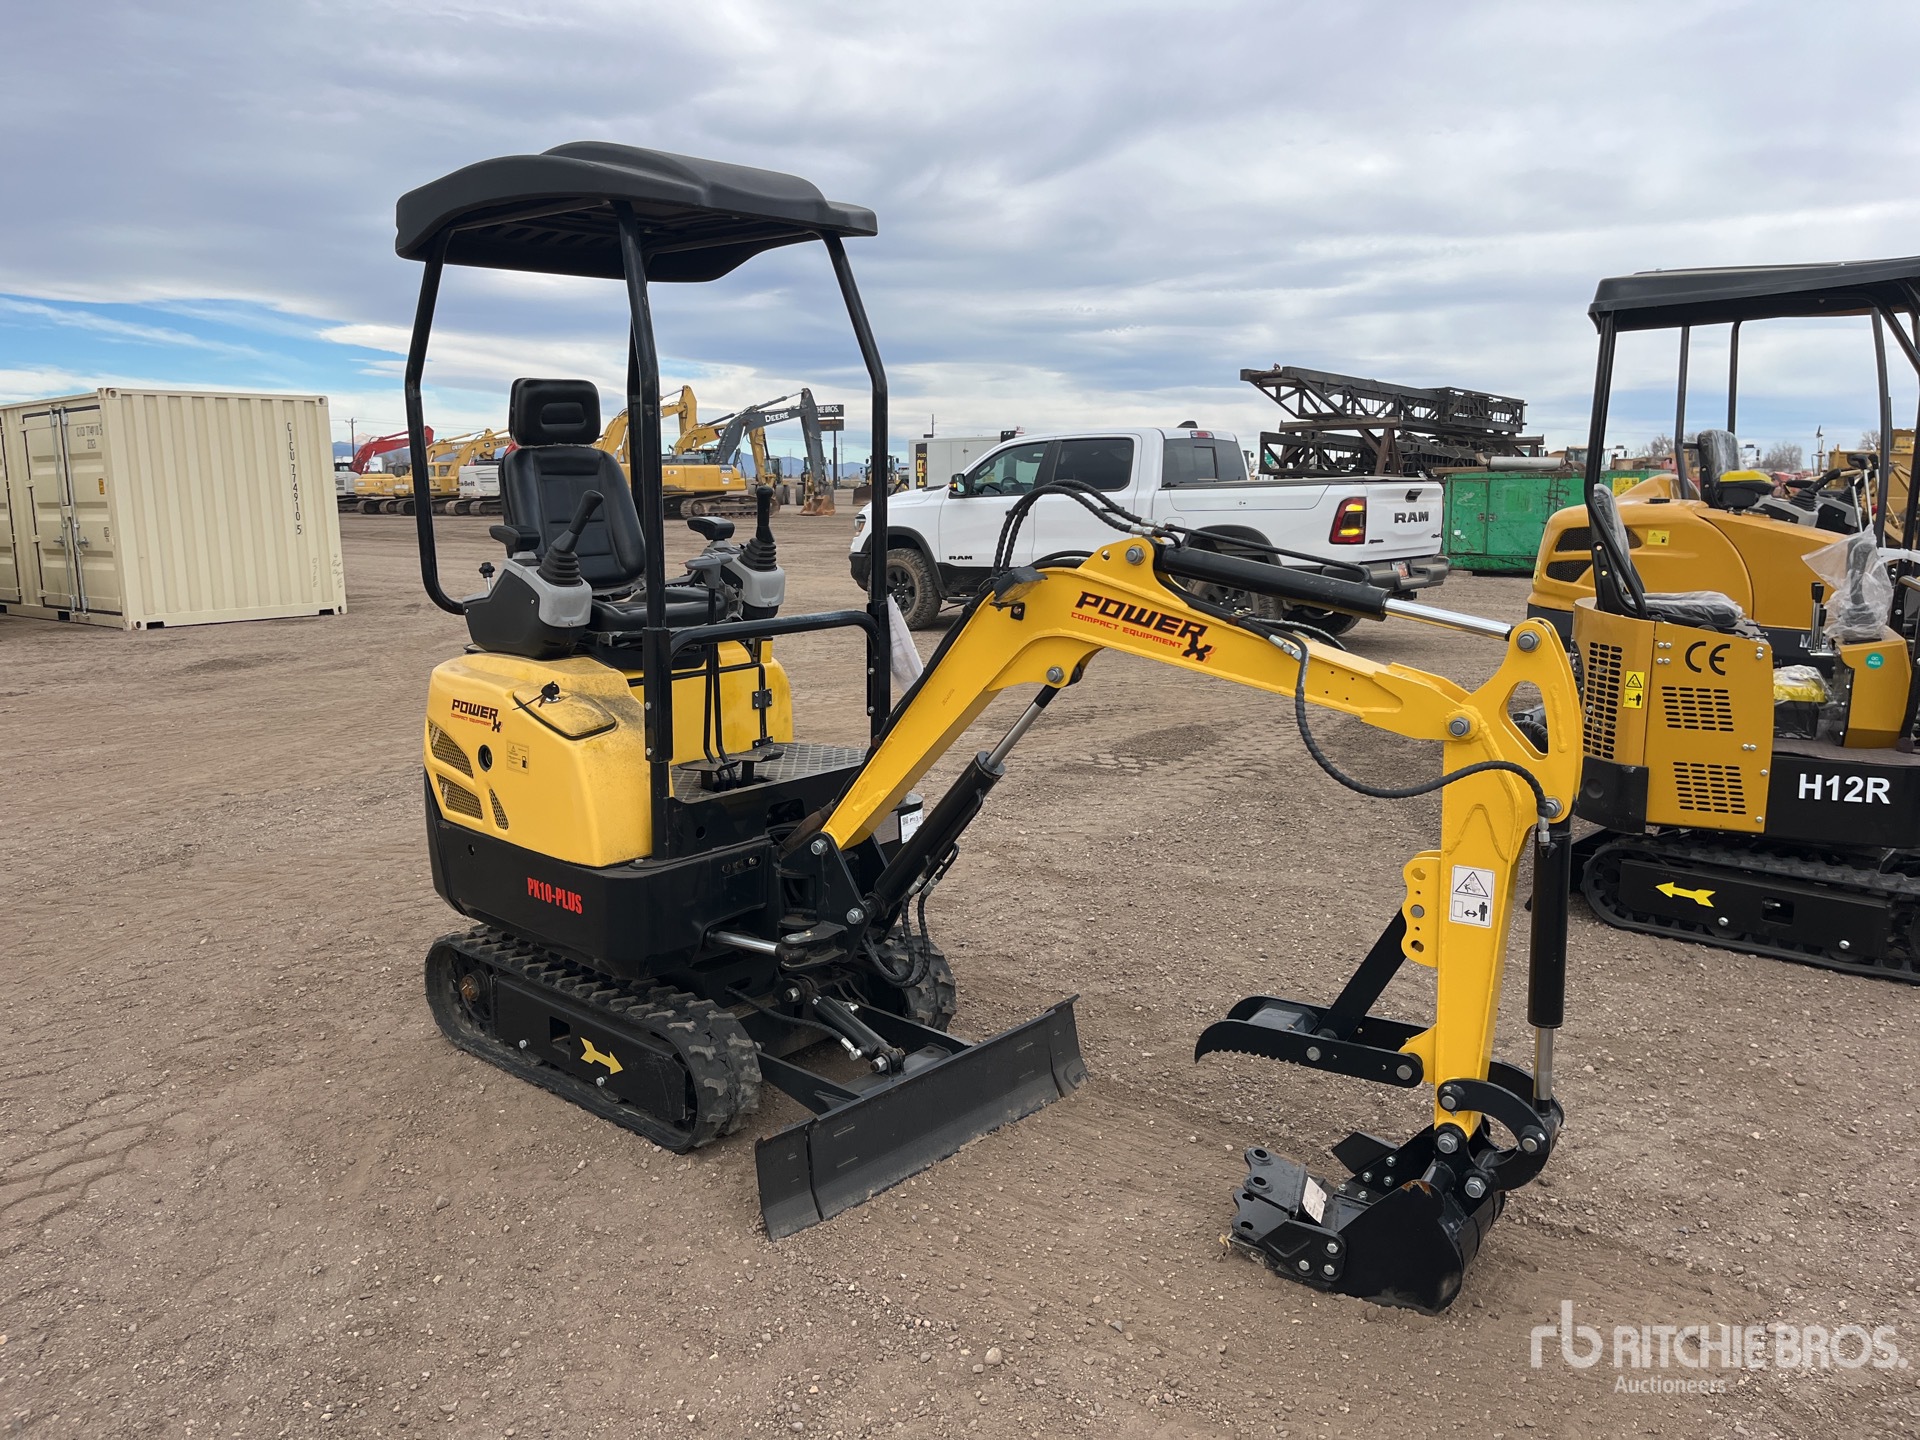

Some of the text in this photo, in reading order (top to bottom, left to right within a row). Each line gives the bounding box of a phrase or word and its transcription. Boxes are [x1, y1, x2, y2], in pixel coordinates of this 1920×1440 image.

[765, 411, 790, 423] DEERE
[291, 463, 301, 521] 774910
[1394, 511, 1429, 524] RAM
[1071, 611, 1183, 649] COMPACT EQUIPMENT
[1075, 591, 1208, 639] POWER
[452, 698, 499, 720] POWER
[1798, 773, 1891, 805] H12R
[527, 877, 583, 915] PX10-PLUS
